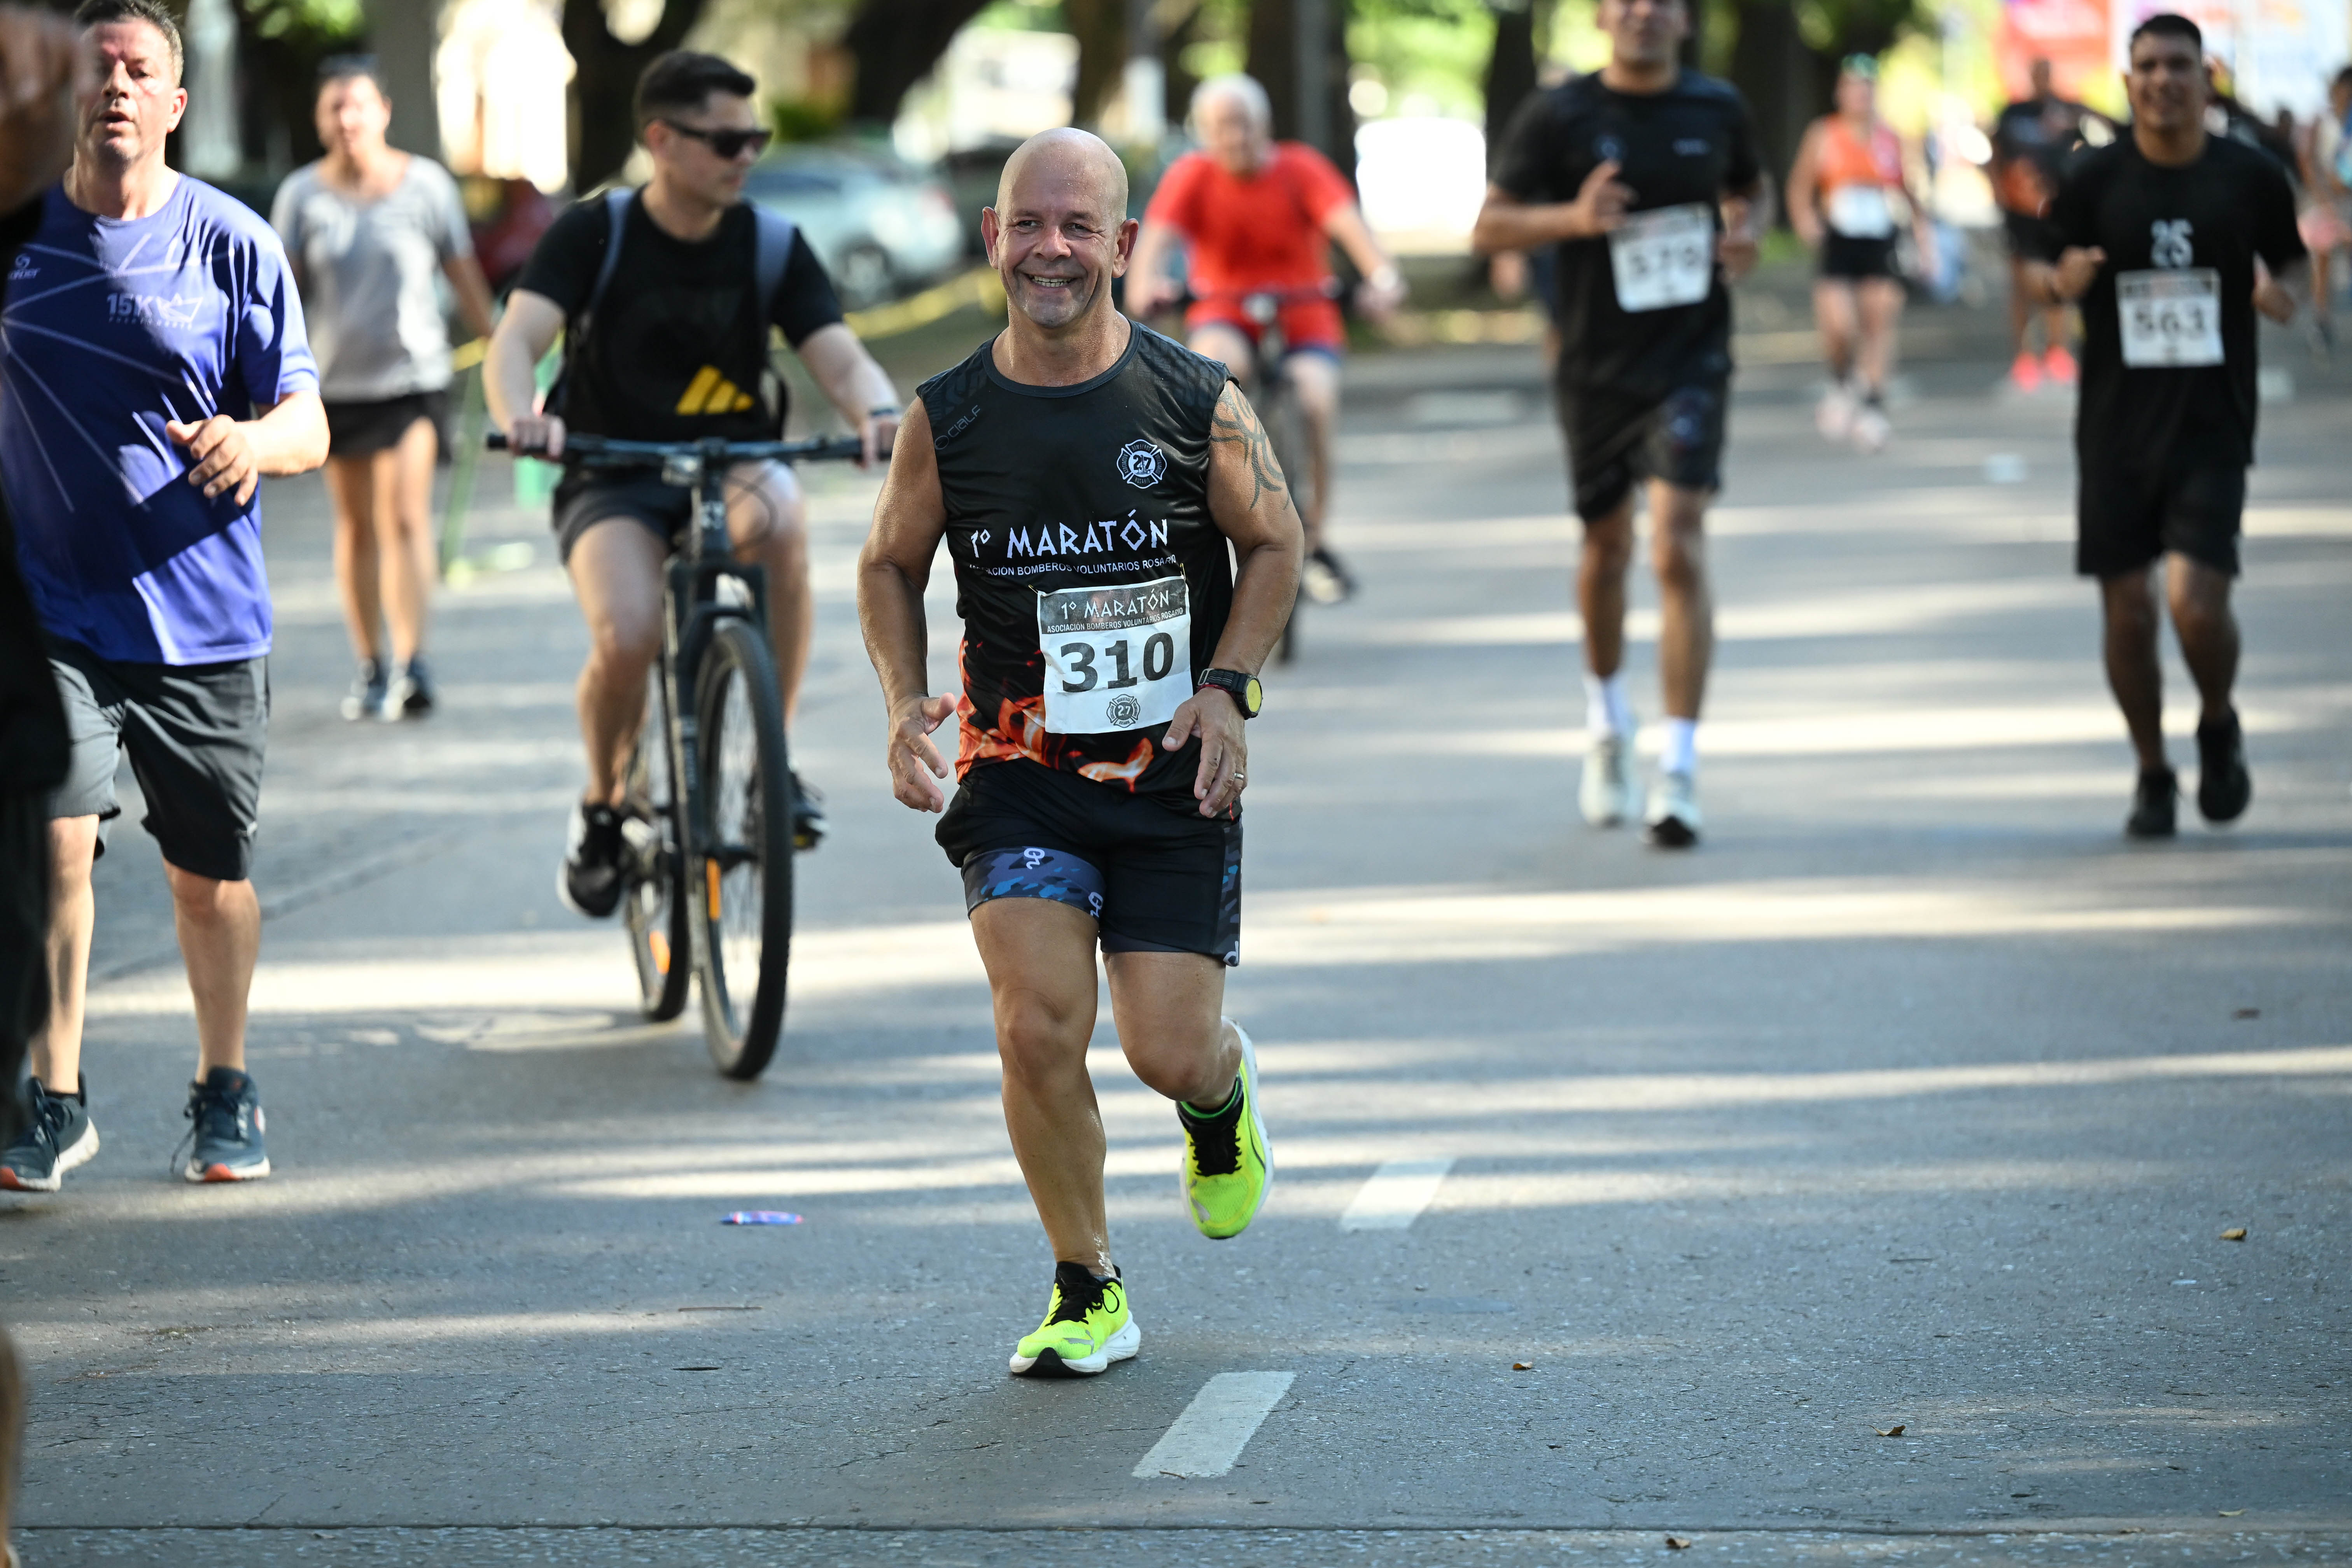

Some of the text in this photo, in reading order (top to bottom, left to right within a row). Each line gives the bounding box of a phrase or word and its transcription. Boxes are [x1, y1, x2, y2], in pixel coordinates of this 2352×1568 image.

[107, 292, 154, 317] 15K
[1133, 454, 1152, 470] 27
[1007, 509, 1167, 558] MARATÓN
[1017, 562, 1072, 576] BOMBEROS
[1073, 561, 1140, 574] VOLUNTARIOS
[1142, 554, 1176, 569] ROSARIO
[1084, 588, 1169, 618] MARATÓN
[1047, 607, 1183, 633] ASOCIACIÓN BOMBEROS VOLUNTARIOS ROSARIO
[1060, 632, 1174, 692] 310
[1117, 705, 1131, 716] 27
